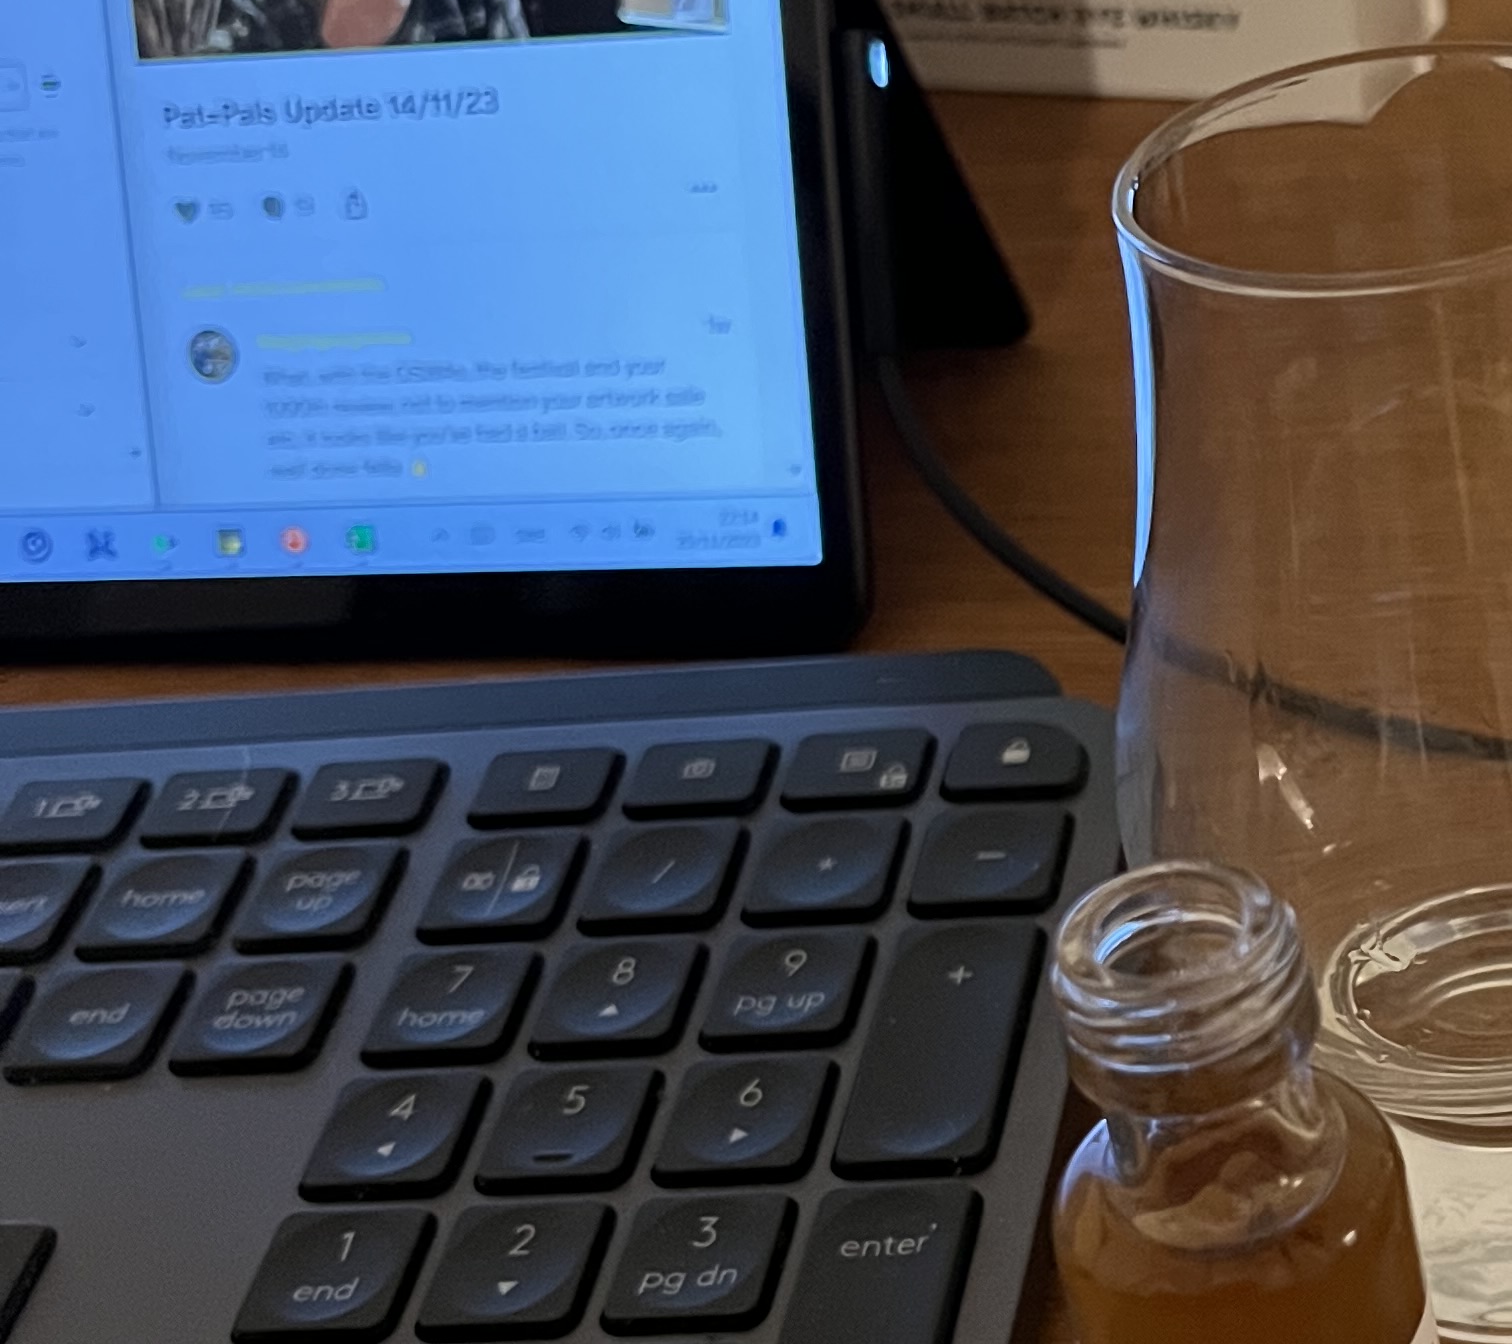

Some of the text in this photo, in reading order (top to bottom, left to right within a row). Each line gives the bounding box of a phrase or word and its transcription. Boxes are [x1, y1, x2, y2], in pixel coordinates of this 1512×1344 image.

[284, 96, 382, 131] Update
[178, 787, 199, 811] 2
[330, 780, 350, 802] 3
[284, 867, 362, 894] page
[120, 885, 206, 909] home
[296, 893, 335, 915] up
[612, 956, 638, 986] 8
[784, 948, 809, 977] 9
[447, 964, 476, 994] 7
[225, 984, 305, 1012] page
[733, 987, 826, 1018] pg up
[69, 1002, 131, 1026] end
[211, 1008, 300, 1032] down
[396, 1006, 487, 1030] home
[389, 1092, 418, 1122] 4
[562, 1085, 590, 1116] 5
[738, 1078, 764, 1109] 6
[508, 1223, 537, 1257] 2
[692, 1215, 719, 1248] 3
[839, 1233, 930, 1258] enter
[338, 1231, 357, 1263] 1
[292, 1277, 361, 1303] end
[637, 1263, 739, 1297] pg dn
